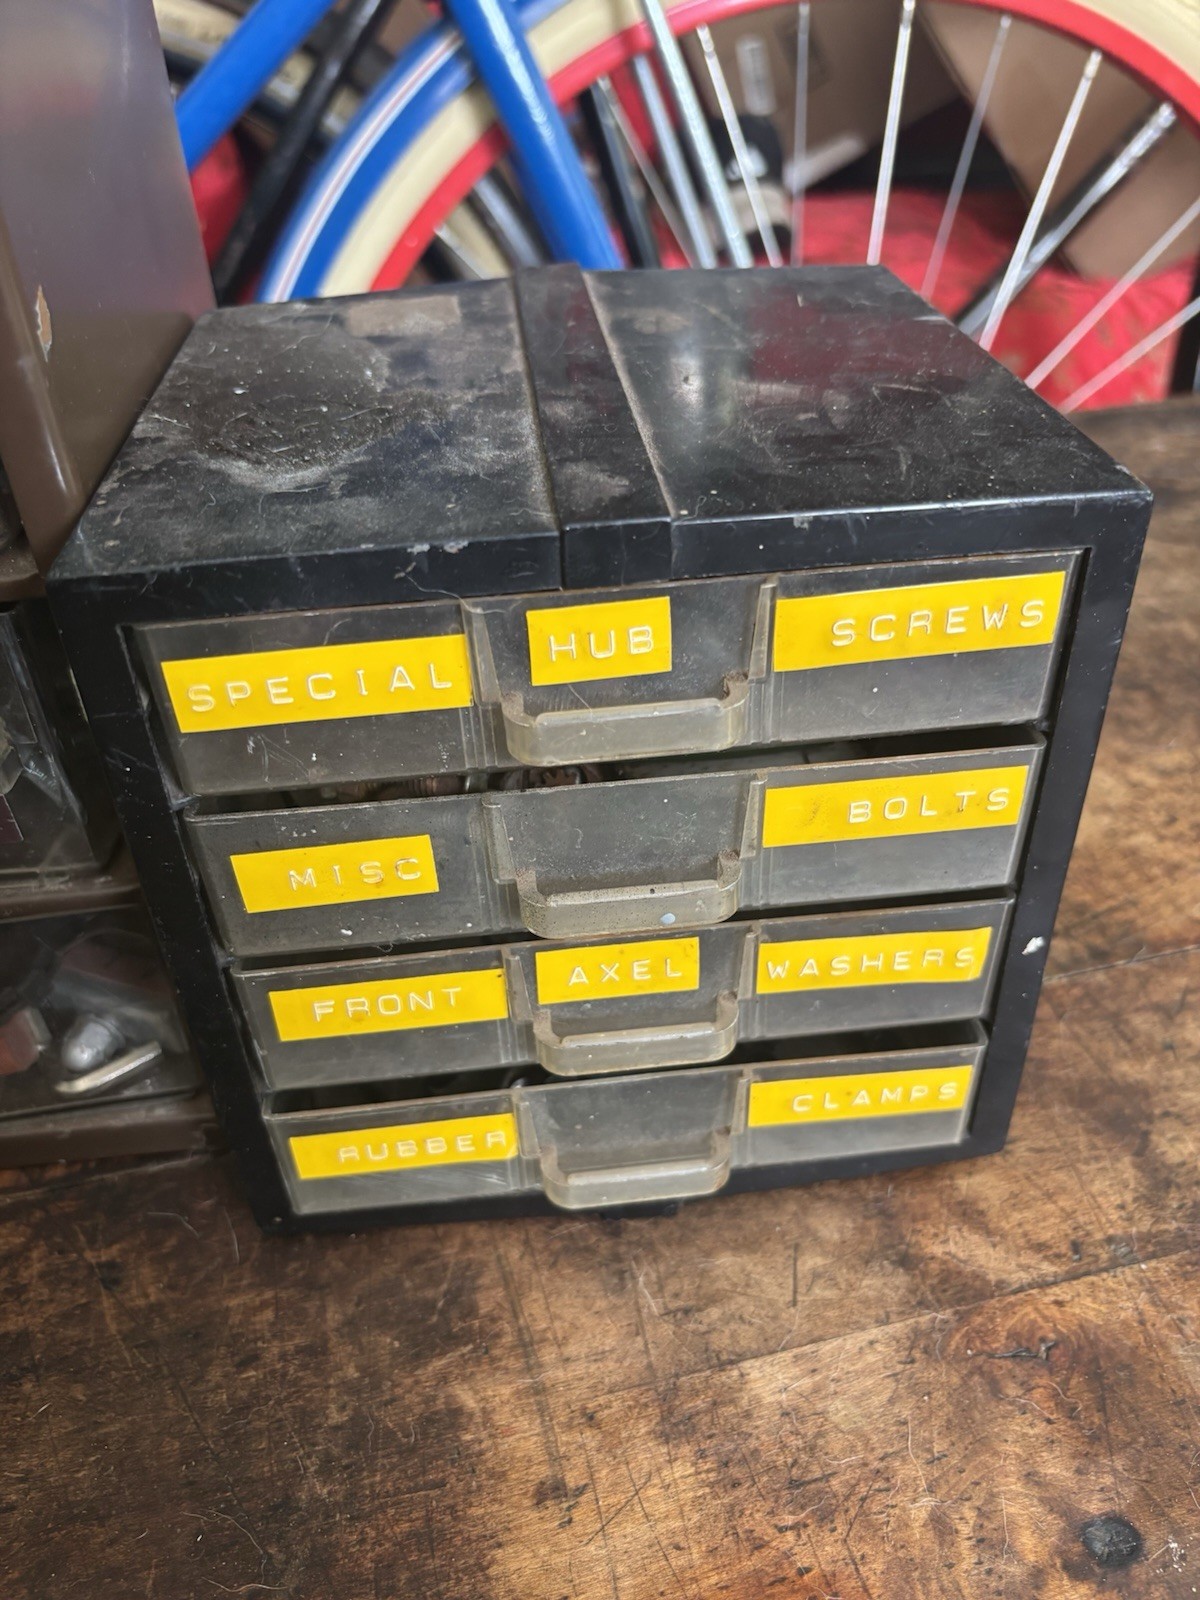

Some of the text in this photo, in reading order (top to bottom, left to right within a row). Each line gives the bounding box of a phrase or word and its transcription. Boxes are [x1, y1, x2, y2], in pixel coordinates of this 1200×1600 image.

[187, 600, 1045, 712] SPECIAL HUB SCREWS
[289, 787, 1009, 890] MISC BOLTS
[312, 947, 975, 1022] FRONT AXEL WASHERS
[338, 1082, 958, 1163] RUBBER CLAMPS
